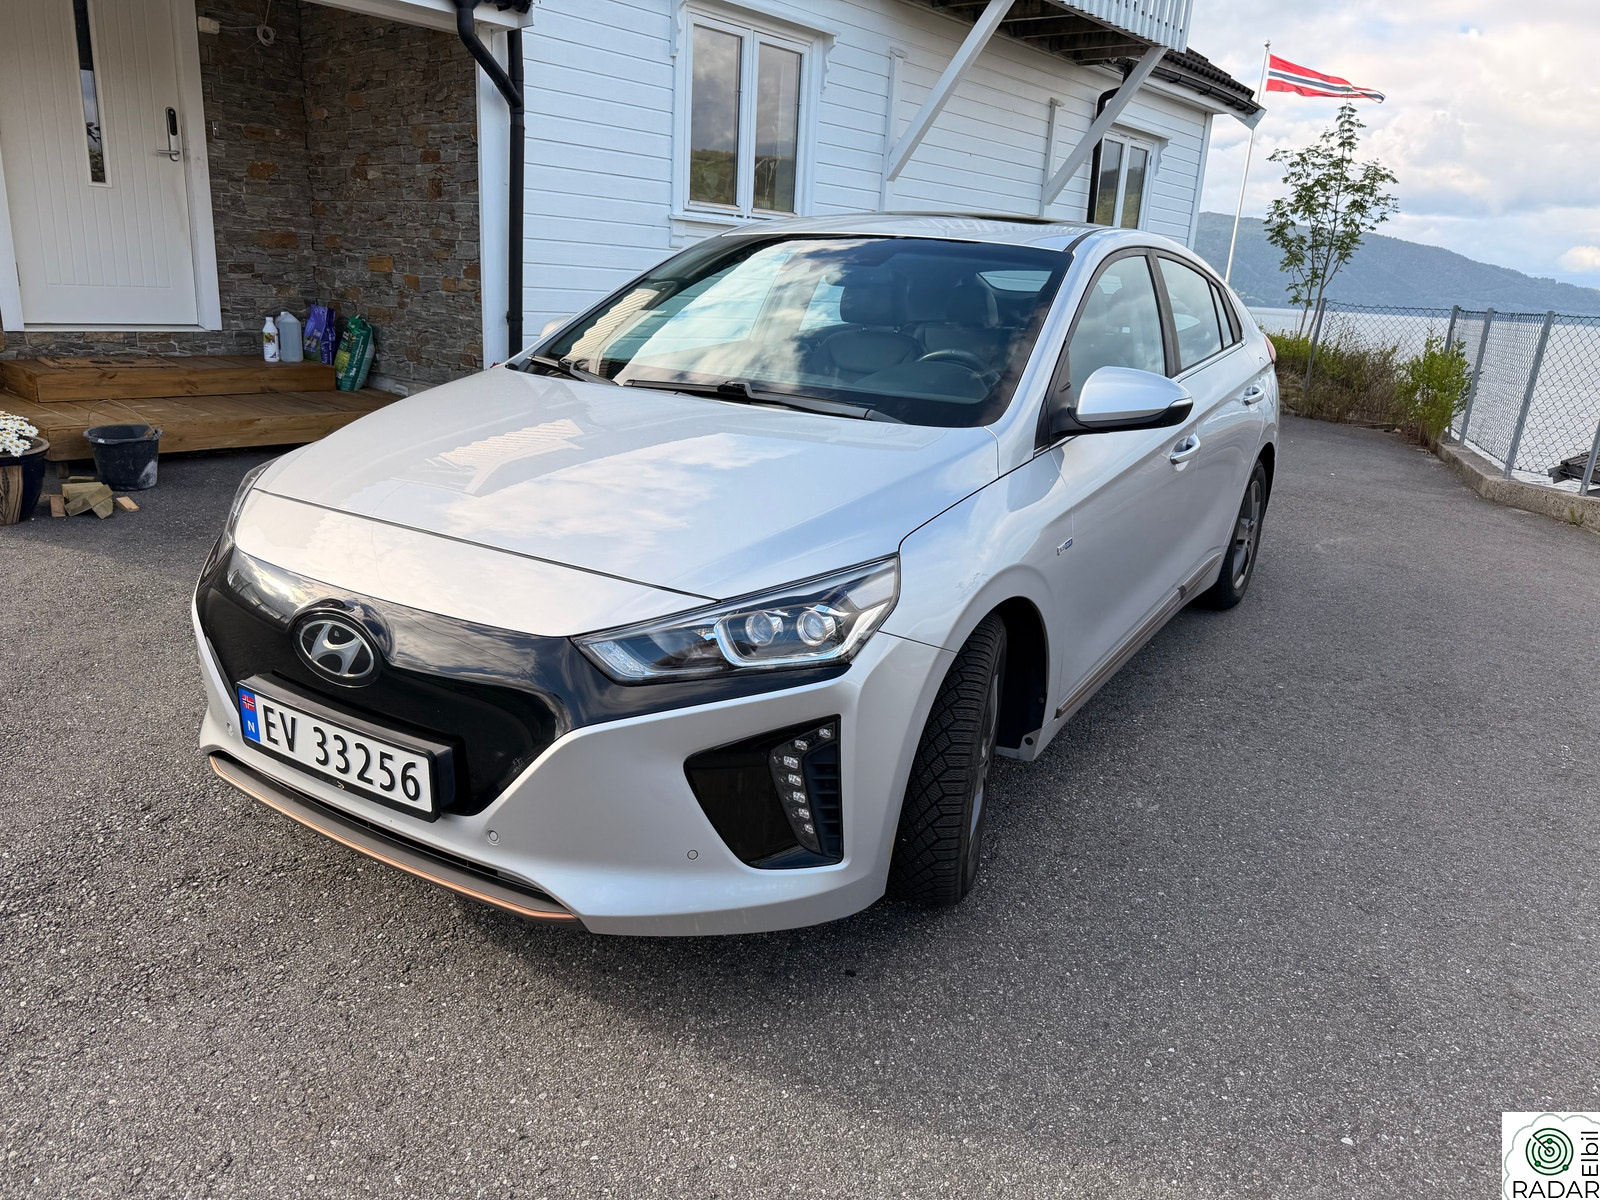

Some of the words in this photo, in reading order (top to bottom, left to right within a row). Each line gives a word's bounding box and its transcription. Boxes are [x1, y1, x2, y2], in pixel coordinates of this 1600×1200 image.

[247, 720, 255, 733] N
[262, 703, 296, 753] EV
[312, 726, 420, 801] 33256
